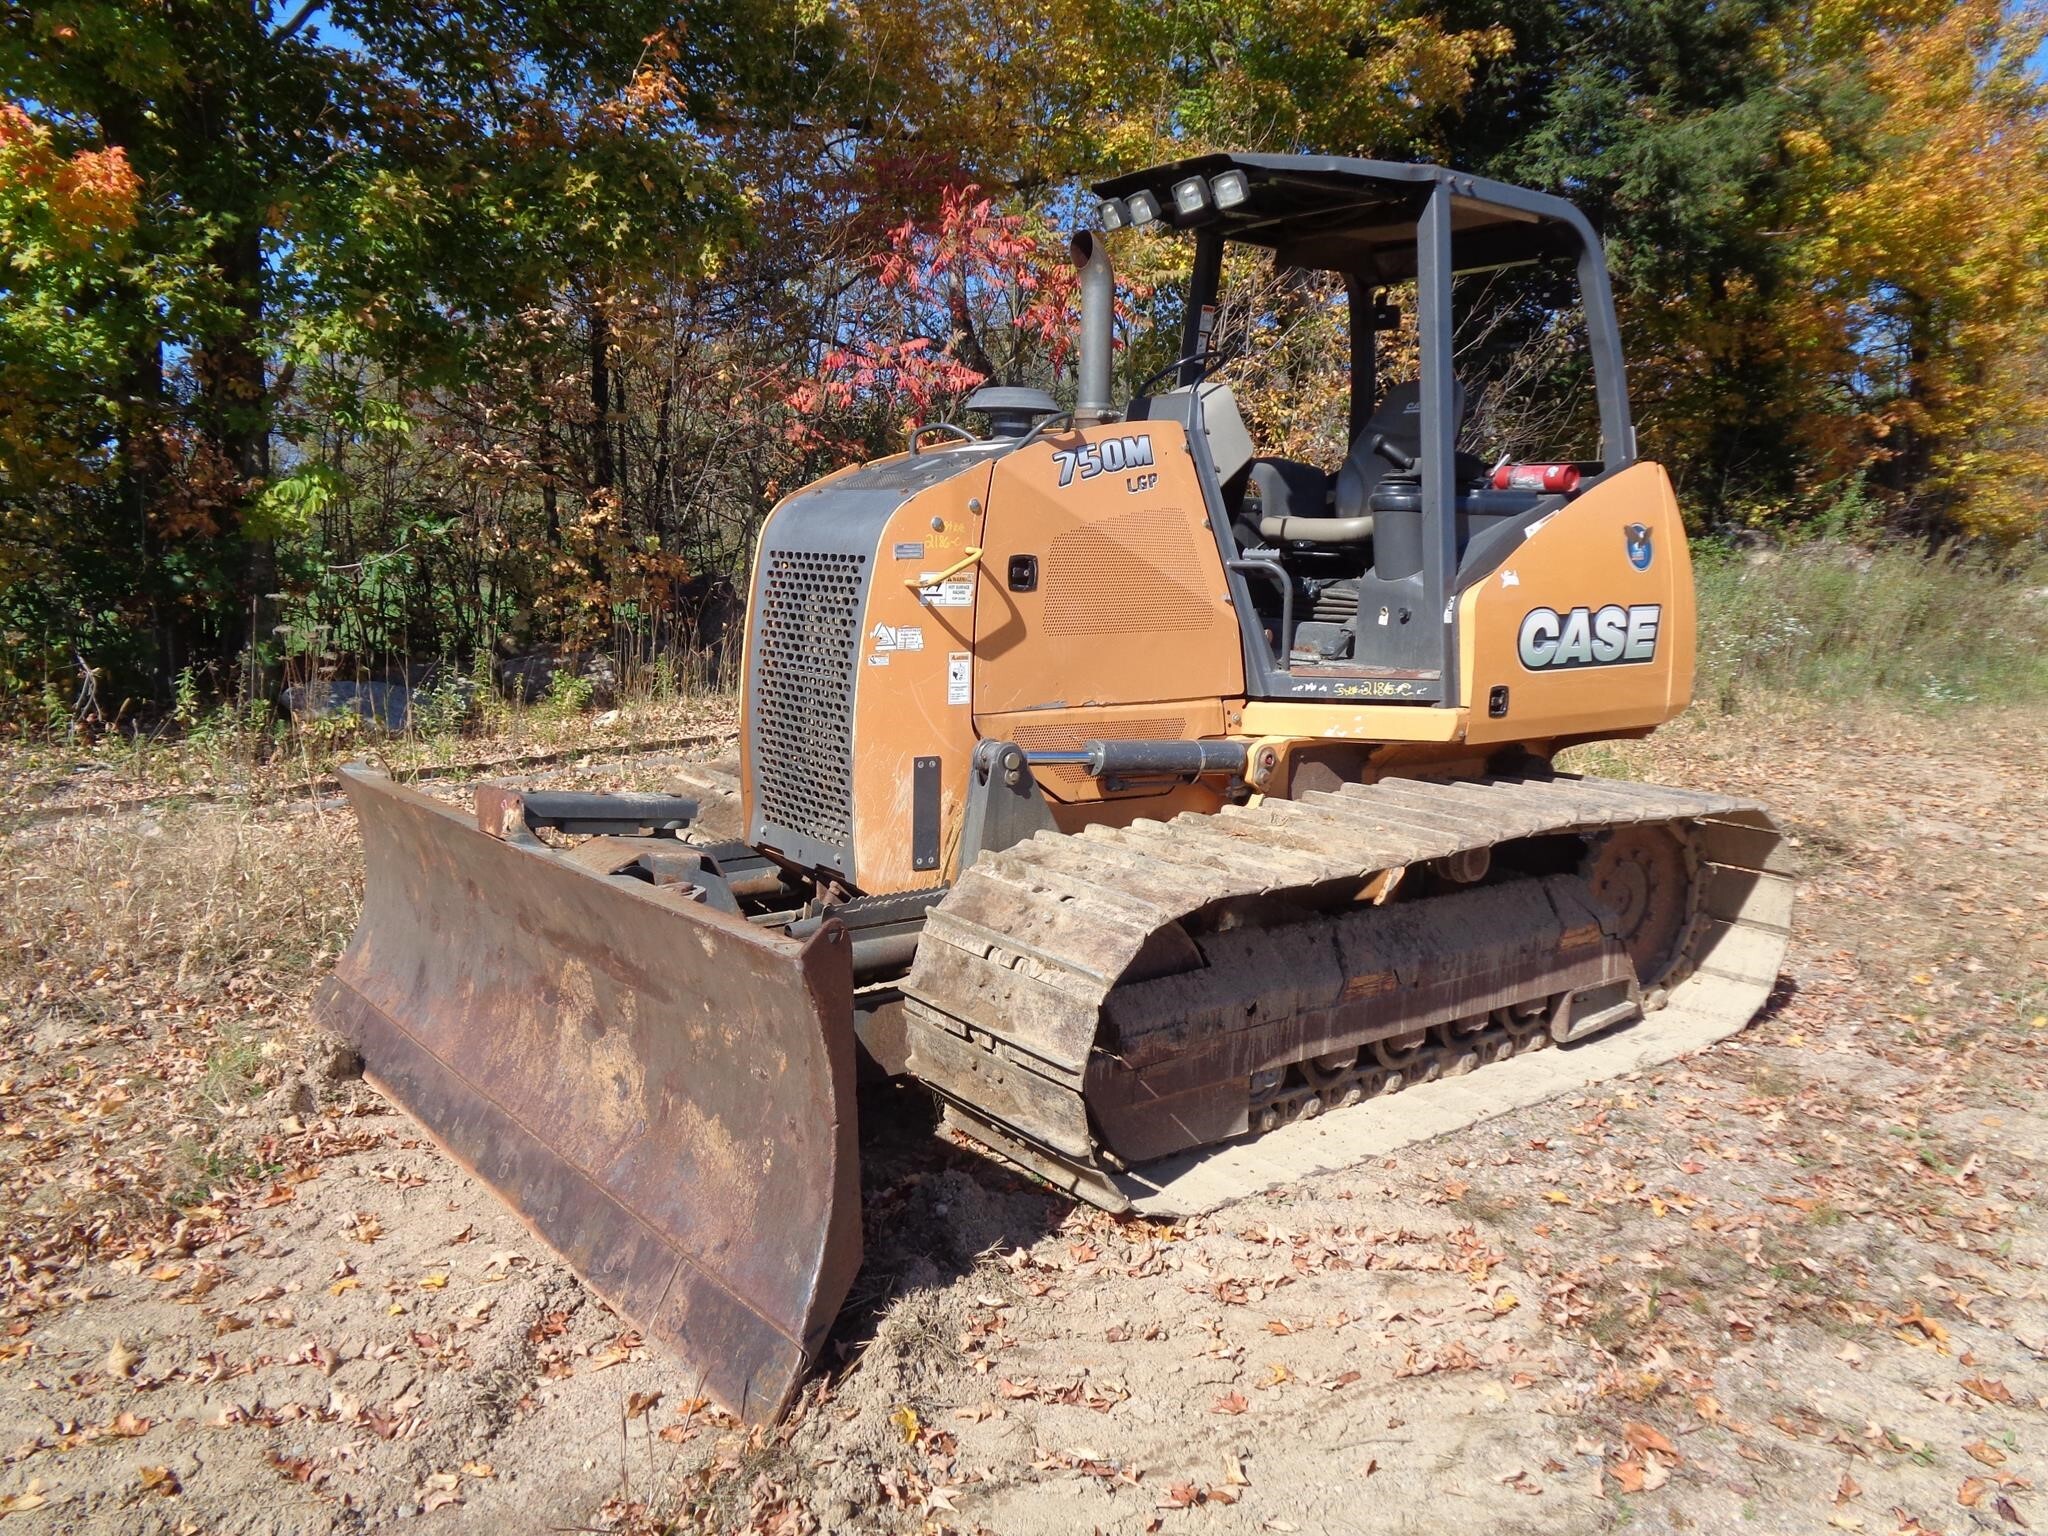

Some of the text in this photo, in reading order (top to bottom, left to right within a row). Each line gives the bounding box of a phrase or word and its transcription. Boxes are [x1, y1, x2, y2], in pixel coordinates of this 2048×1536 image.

[1052, 435, 1155, 487] 750M
[1127, 473, 1158, 493] LGP
[1517, 604, 1661, 669] CASE
